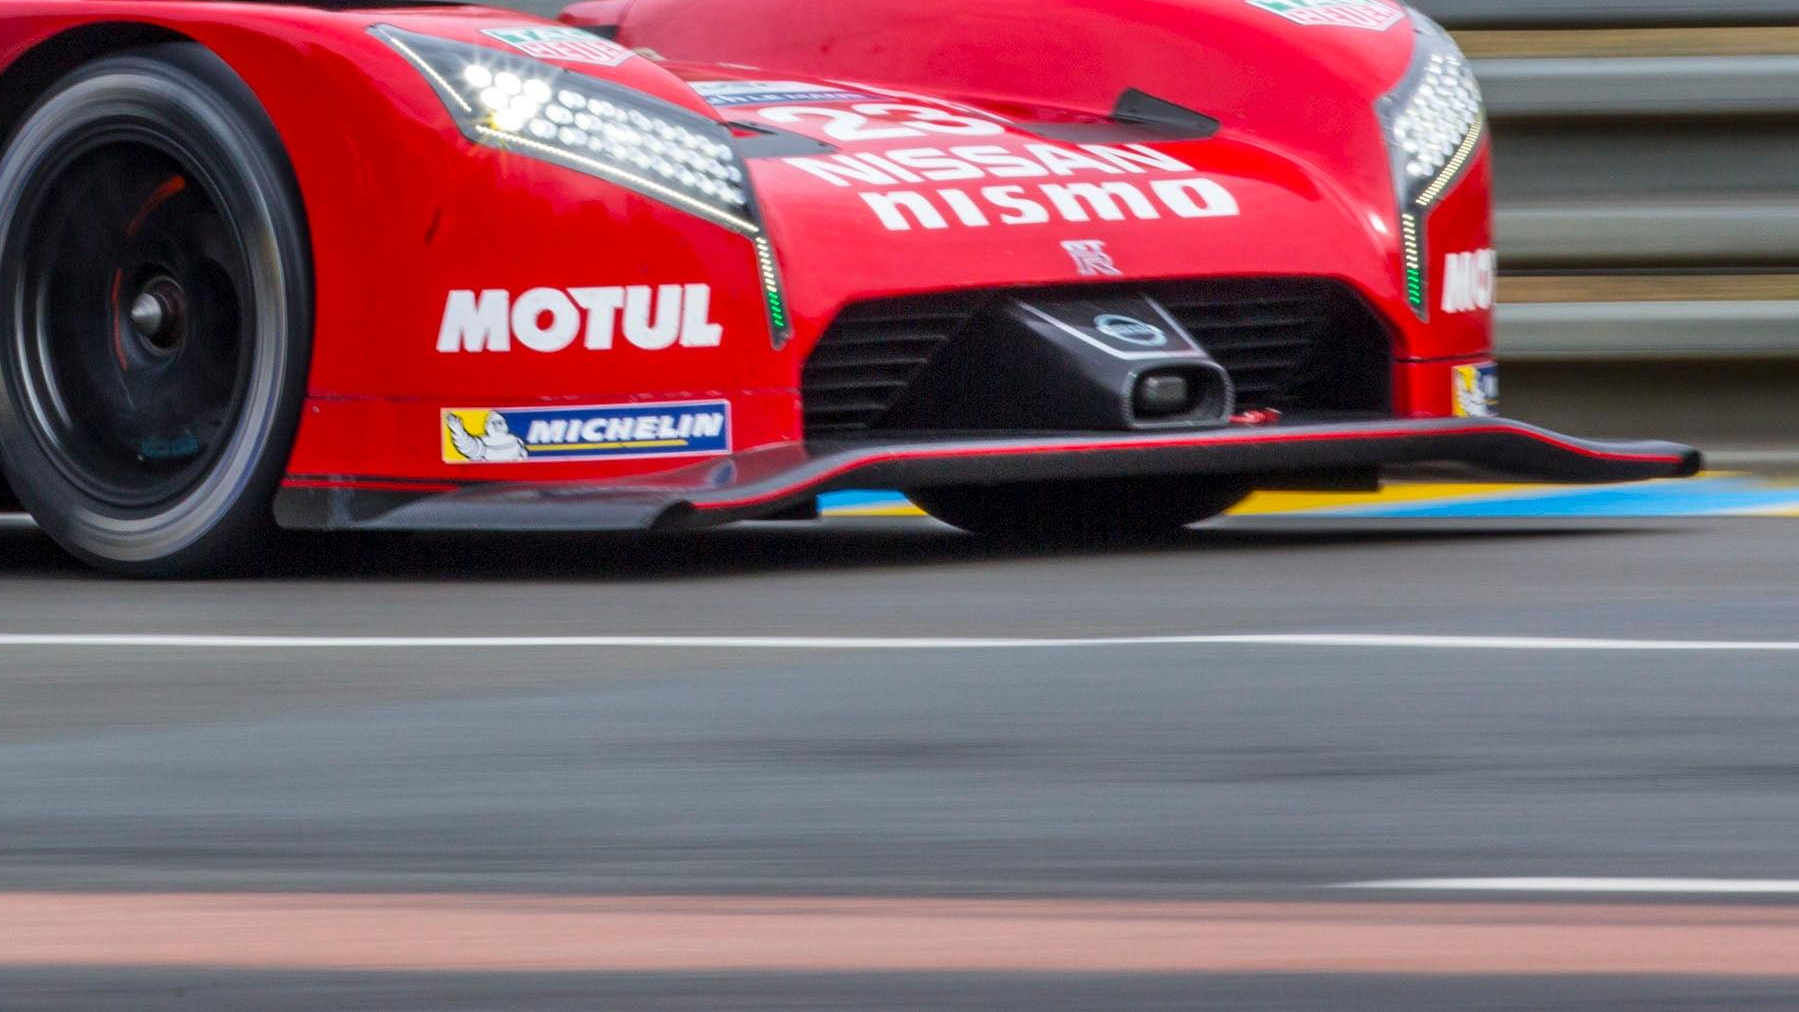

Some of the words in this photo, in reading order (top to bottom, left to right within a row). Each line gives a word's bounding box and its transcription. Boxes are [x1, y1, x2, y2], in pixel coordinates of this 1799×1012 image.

[758, 104, 1005, 140] 23
[783, 144, 1195, 187] NISSAN
[860, 178, 1240, 231] nismo
[436, 284, 723, 352] MOTUL
[527, 412, 724, 444] MICHELIN
